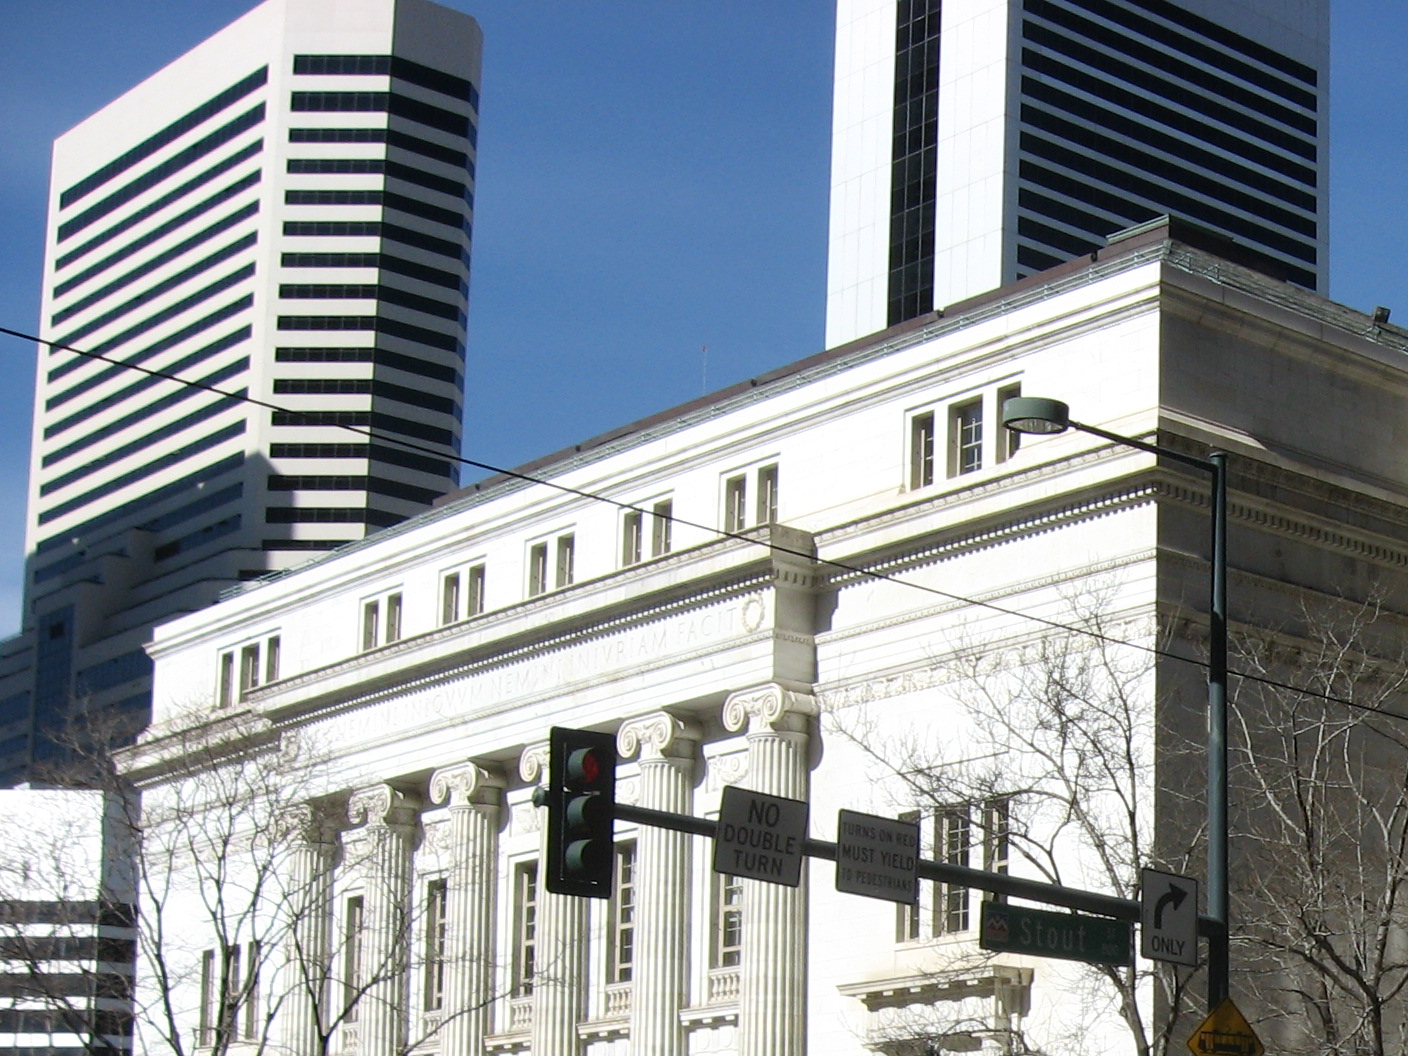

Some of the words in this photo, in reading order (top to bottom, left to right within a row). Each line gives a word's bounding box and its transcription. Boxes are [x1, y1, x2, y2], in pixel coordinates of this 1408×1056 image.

[749, 800, 780, 828] NO
[724, 825, 797, 855] DOUBLE
[842, 822, 877, 839] TURNS
[879, 829, 893, 842] ON
[896, 833, 915, 848] RED
[734, 850, 783, 877] TURN
[842, 844, 876, 864] MUST
[881, 852, 915, 872] YIELD
[841, 868, 852, 881] TO
[855, 870, 913, 892] PEDESTRIANS
[1020, 917, 1086, 952] Stout
[1151, 935, 1186, 956] ONLY
